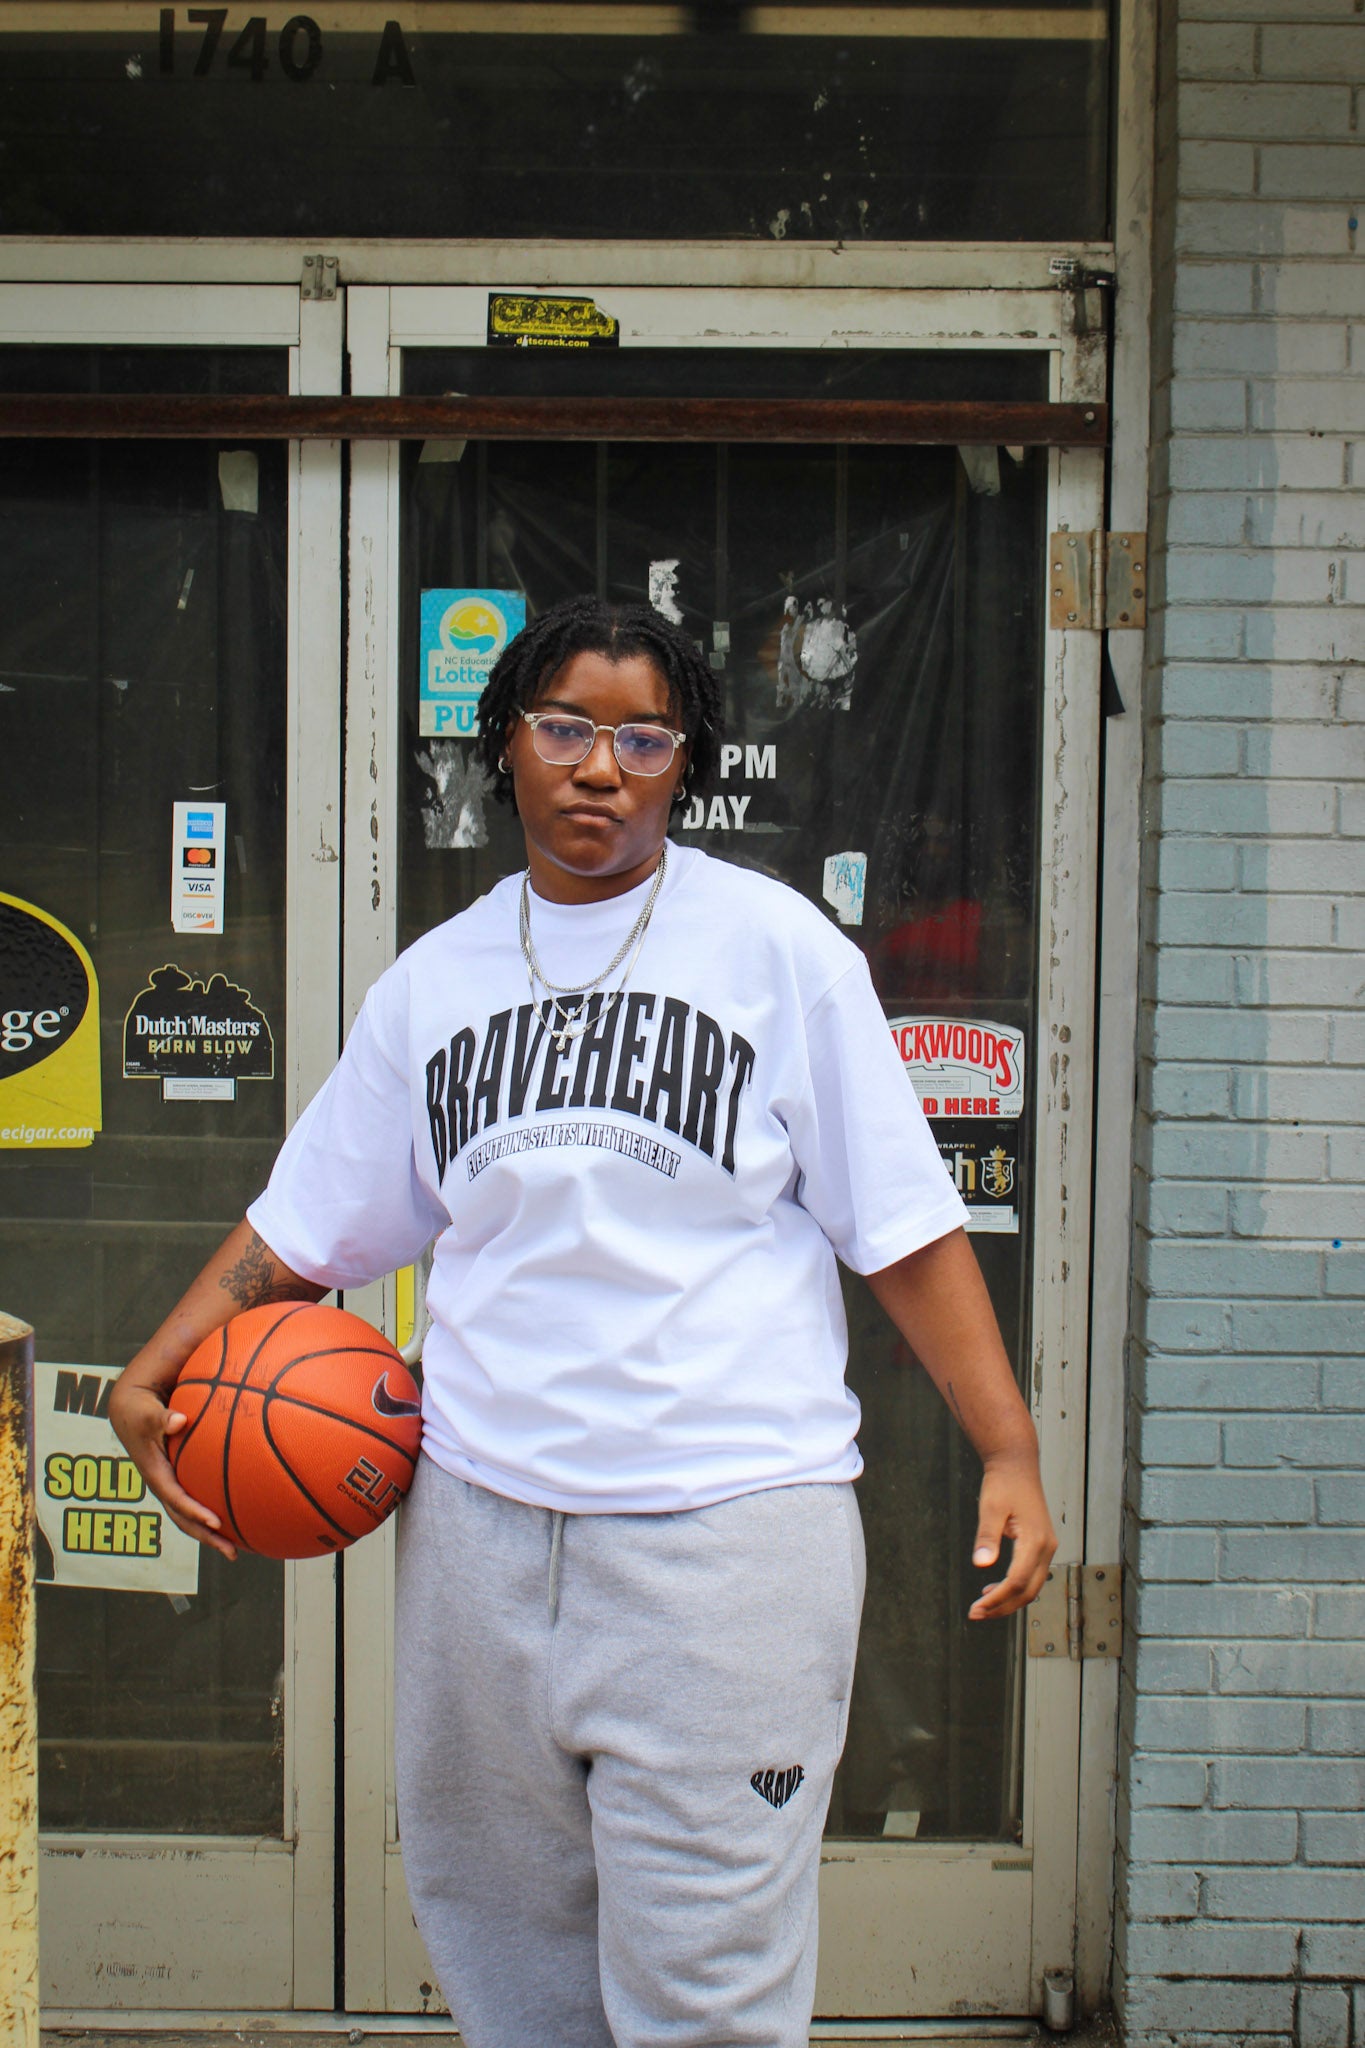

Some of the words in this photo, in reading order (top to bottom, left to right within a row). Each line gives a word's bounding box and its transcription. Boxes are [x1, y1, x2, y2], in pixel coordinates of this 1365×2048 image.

[160, 8, 322, 82] 1740
[372, 20, 416, 87] A
[516, 336, 590, 347] dtscrack.com
[434, 666, 489, 683] Lotte
[444, 656, 458, 665] NC
[460, 655, 499, 665] Educatio
[434, 705, 476, 732] PU
[720, 744, 776, 779] PM
[188, 883, 211, 892] VISA
[0, 1009, 61, 1052] ge
[136, 1015, 187, 1036] Dutch
[148, 1037, 196, 1054] BURN
[203, 1039, 253, 1054] SLOW
[426, 991, 756, 1187] BRAVEHEART
[944, 1097, 1001, 1115] HERE
[467, 1129, 530, 1182] EVERYTHING
[528, 1123, 577, 1149] STARTS
[577, 1123, 614, 1149] WITH
[613, 1126, 642, 1162] THE
[640, 1137, 681, 1179] HEART
[44, 1453, 146, 1503] SOLD
[64, 1508, 161, 1558] HERE
[750, 1764, 805, 1809] BRAVE
